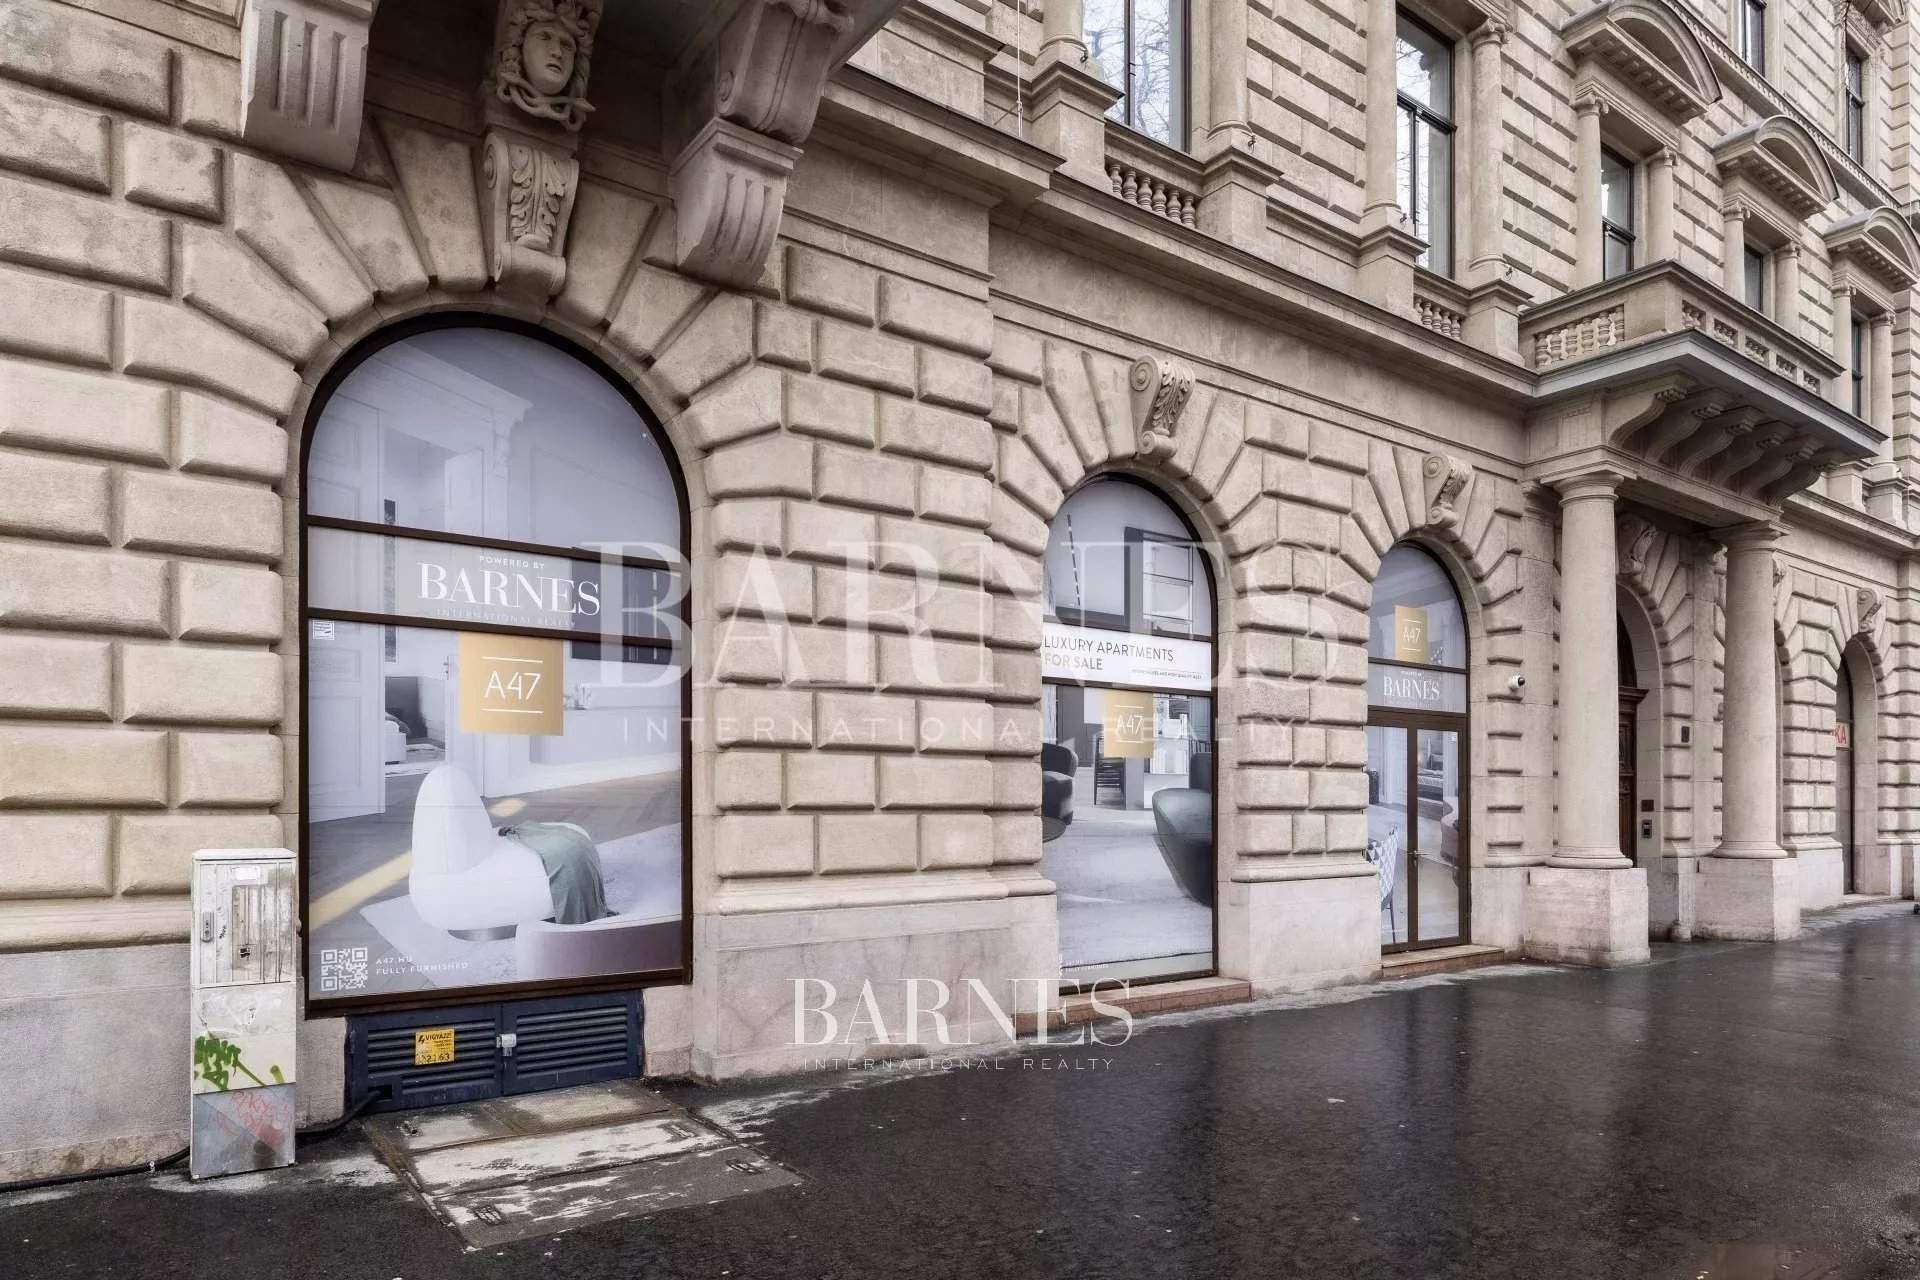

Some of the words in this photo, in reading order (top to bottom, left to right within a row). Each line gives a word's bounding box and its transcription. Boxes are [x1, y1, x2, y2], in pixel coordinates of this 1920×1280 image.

[417, 562, 601, 616] BARNES
[1044, 634, 1094, 653] LUXURY
[1096, 641, 1174, 662] APARTMENTS
[1045, 653, 1071, 667] FOR
[1074, 656, 1103, 671] SALE
[484, 670, 541, 700] A47
[1383, 676, 1440, 700] BARNES
[1116, 714, 1145, 736] A47
